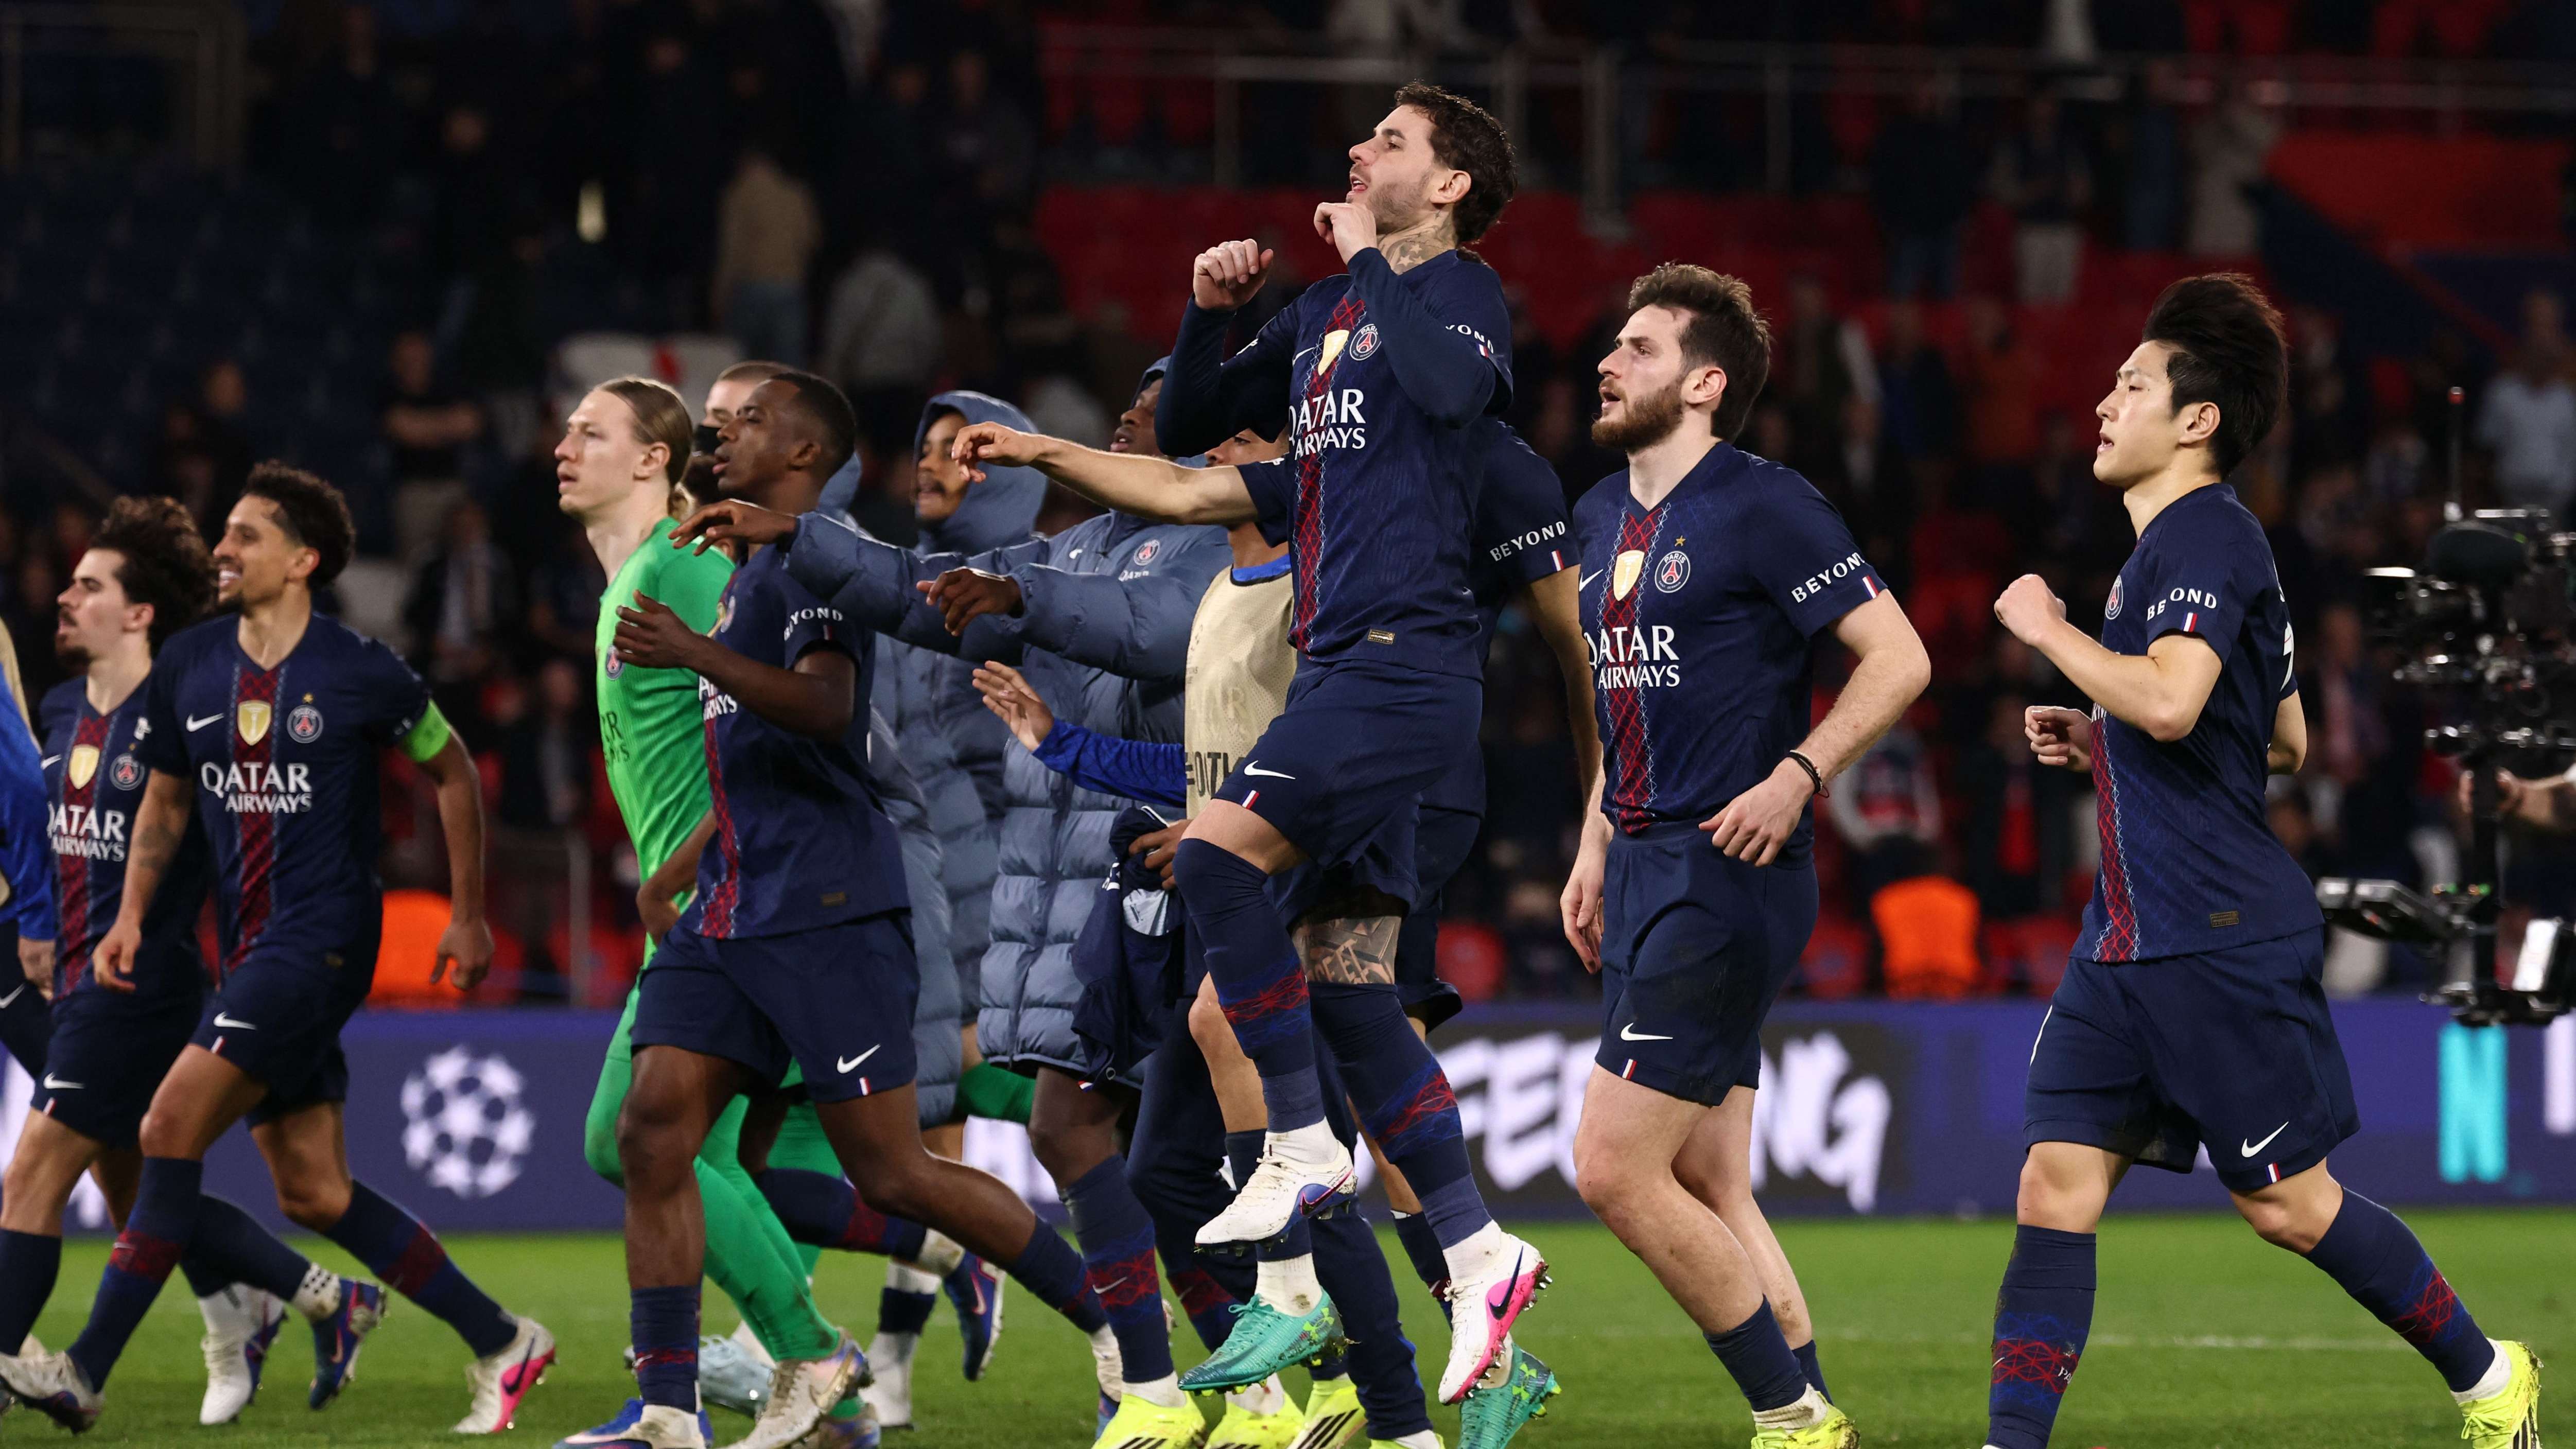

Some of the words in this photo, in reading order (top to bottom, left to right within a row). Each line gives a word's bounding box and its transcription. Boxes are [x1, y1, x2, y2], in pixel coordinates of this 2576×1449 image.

[1489, 521, 1566, 562] BEYOND
[1664, 553, 1686, 564] PARIS
[2147, 588, 2217, 621] BEOND
[1598, 665, 1681, 690] AIRWAYS
[200, 761, 313, 798] QATAR
[225, 793, 313, 814] AIRWAYS
[51, 835, 125, 862] AIRWAYS
